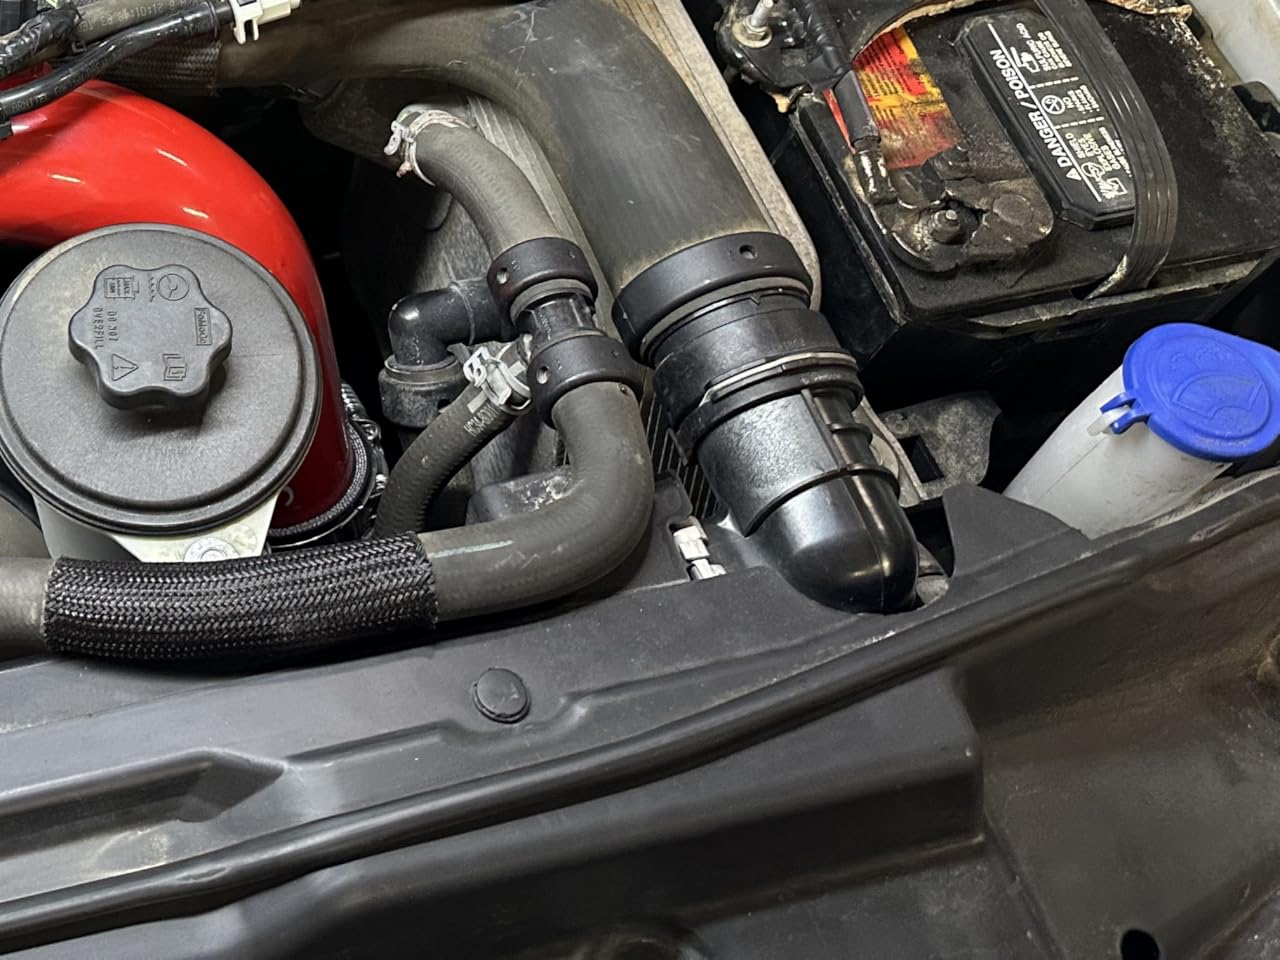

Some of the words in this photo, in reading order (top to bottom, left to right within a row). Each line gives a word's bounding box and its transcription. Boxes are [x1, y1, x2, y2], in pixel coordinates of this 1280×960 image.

[1016, 22, 1031, 39] ACID
[1026, 40, 1052, 71] SULFURIC
[990, 49, 1030, 100] POISON
[1062, 96, 1075, 109] NO
[1028, 106, 1073, 168] DANGER
[1065, 132, 1086, 159] SHIELD
[1078, 138, 1095, 157] EYES
[1082, 132, 1113, 172] EXPLOSIVE
[1100, 145, 1121, 170] GASES
[93, 307, 104, 350] OVERFILL
[108, 311, 117, 322] DO
[108, 325, 118, 342] NOT
